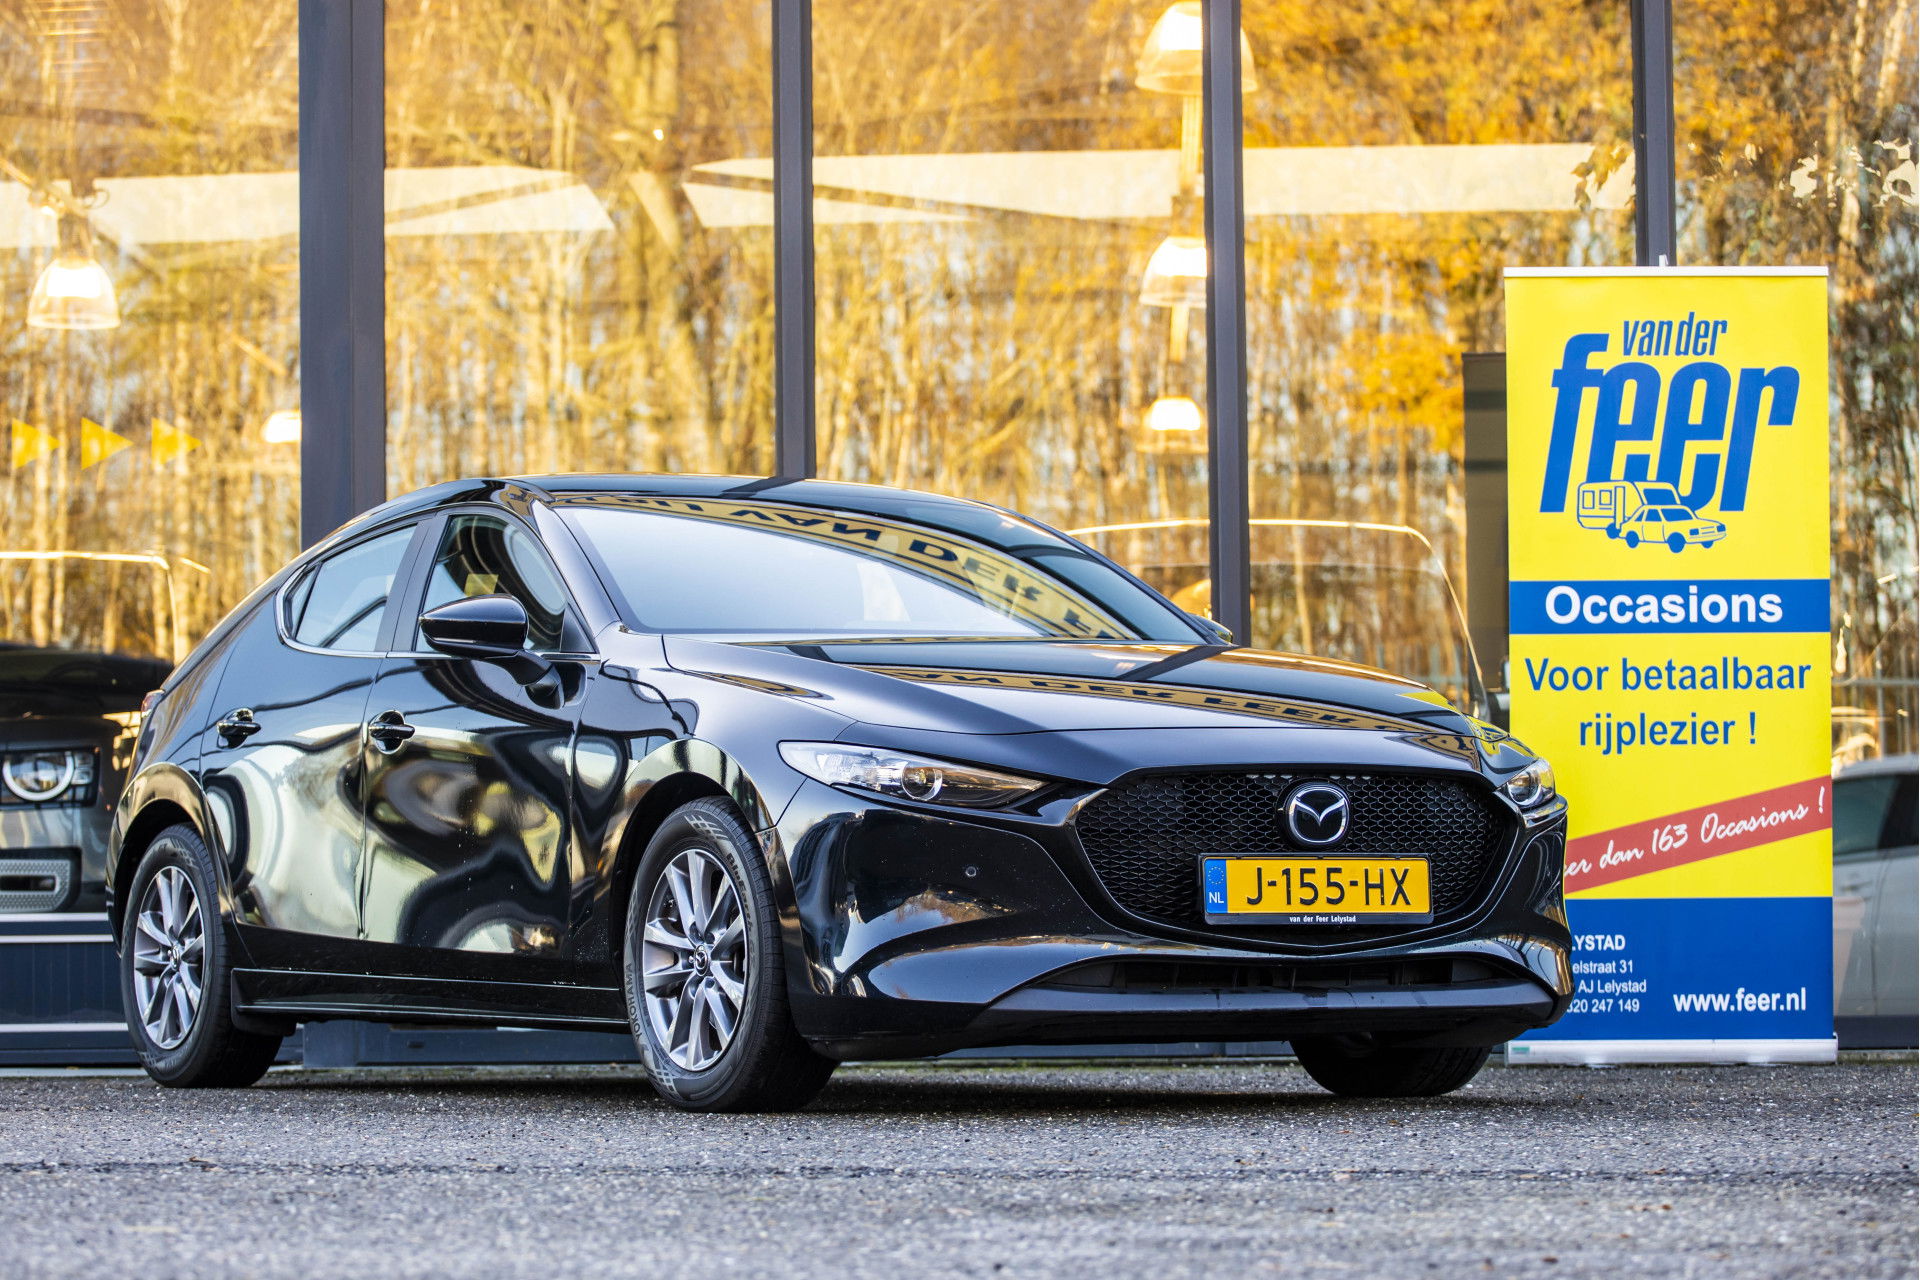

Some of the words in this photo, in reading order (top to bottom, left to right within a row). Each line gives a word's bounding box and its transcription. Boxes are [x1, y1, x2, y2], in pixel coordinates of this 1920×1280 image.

[1623, 320, 1673, 356] van
[1675, 311, 1728, 356] der
[1540, 333, 1800, 513] feer
[1545, 585, 1783, 625] Occasions
[1525, 657, 1609, 691] Voor
[1622, 656, 1812, 691] betaalbaar
[1579, 711, 1736, 754] rijplezier
[1749, 711, 1757, 745] !
[1600, 840, 1644, 869] dan
[1652, 824, 1689, 855] 163
[1700, 804, 1809, 844] Occasions
[1817, 786, 1826, 814] !
[1209, 892, 1224, 904] NL
[1247, 867, 1411, 905] J-155-HX
[1303, 915, 1313, 923] der
[1316, 915, 1329, 923] Feer
[1331, 915, 1356, 924] Lelystad
[1571, 934, 1626, 951] YSTAD
[1572, 960, 1616, 974] elstraat
[1619, 960, 1633, 974] 31
[626, 963, 643, 1041] YOKOHAMA
[1578, 979, 1594, 993] AJ
[1597, 979, 1647, 996] Lelystad
[1673, 988, 1806, 1013] www.feer.nl
[1591, 999, 1613, 1013] 247
[1618, 999, 1640, 1013] 149
